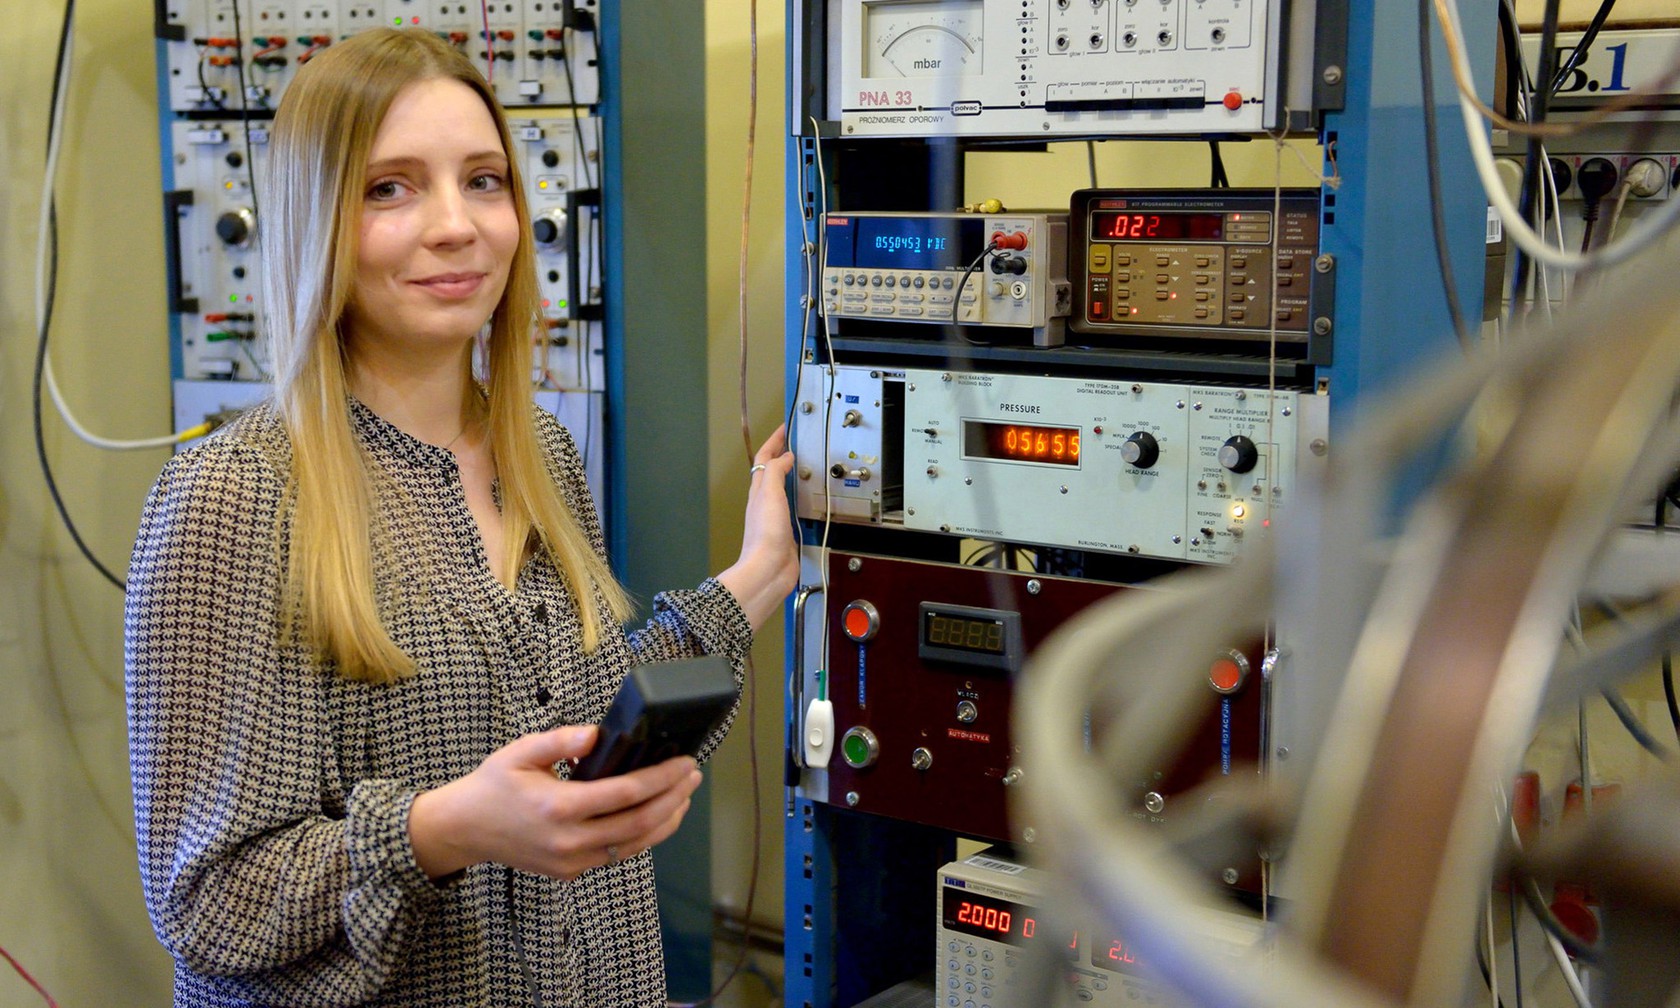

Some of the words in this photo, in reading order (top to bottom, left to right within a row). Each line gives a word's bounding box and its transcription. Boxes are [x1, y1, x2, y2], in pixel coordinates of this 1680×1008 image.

[913, 58, 941, 69] mbar
[860, 91, 889, 106] PNA
[895, 90, 913, 106] 33
[954, 103, 978, 113] polvac
[909, 115, 944, 123] OPOROWY
[1109, 215, 1160, 237] .022
[1000, 403, 1041, 414] PRESSURE
[1007, 429, 1080, 456] 05655
[1125, 468, 1140, 476] HEAD
[948, 729, 990, 741] AUTOMATYKA
[986, 887, 1004, 895] POWER
[958, 902, 1011, 933] 2.000
